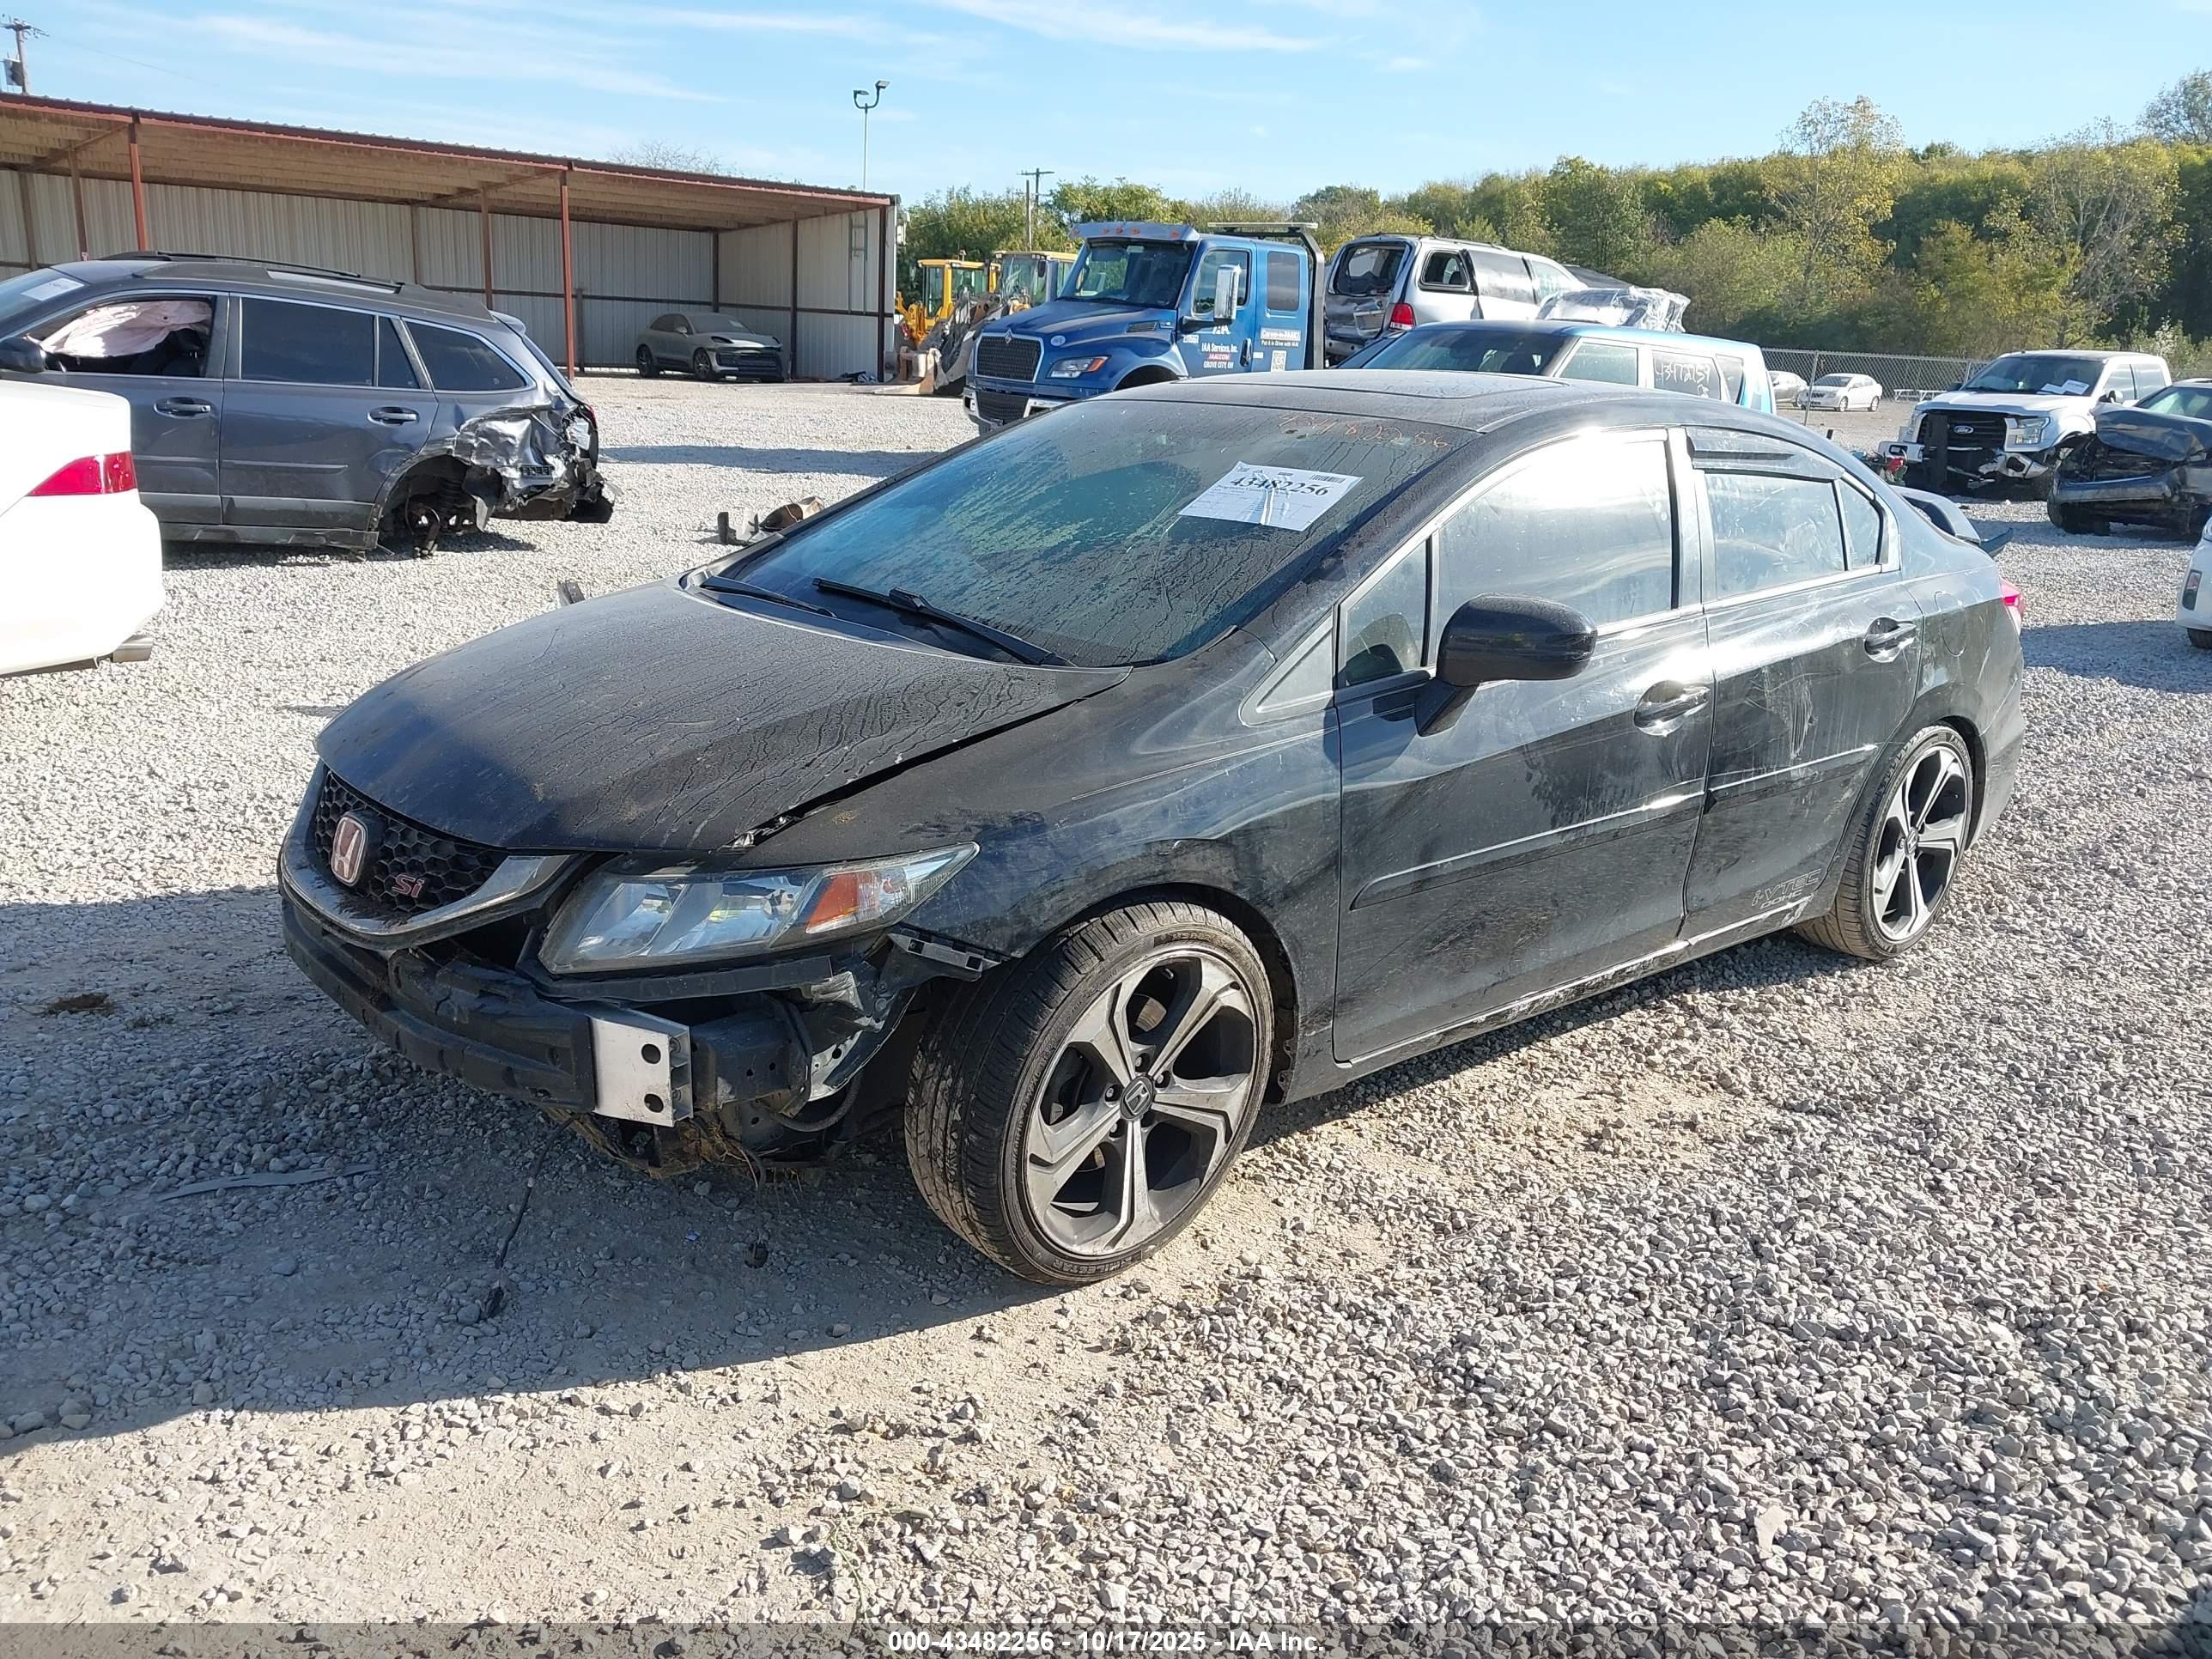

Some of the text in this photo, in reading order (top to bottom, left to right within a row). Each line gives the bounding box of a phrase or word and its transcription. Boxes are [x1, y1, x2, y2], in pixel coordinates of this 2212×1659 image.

[1231, 476, 1334, 497] 43482256
[392, 873, 425, 898] Si
[1752, 868, 1821, 907] i-VTEC
[1760, 889, 1803, 909] DOHC
[1052, 1257, 1121, 1274] MILESTAR
